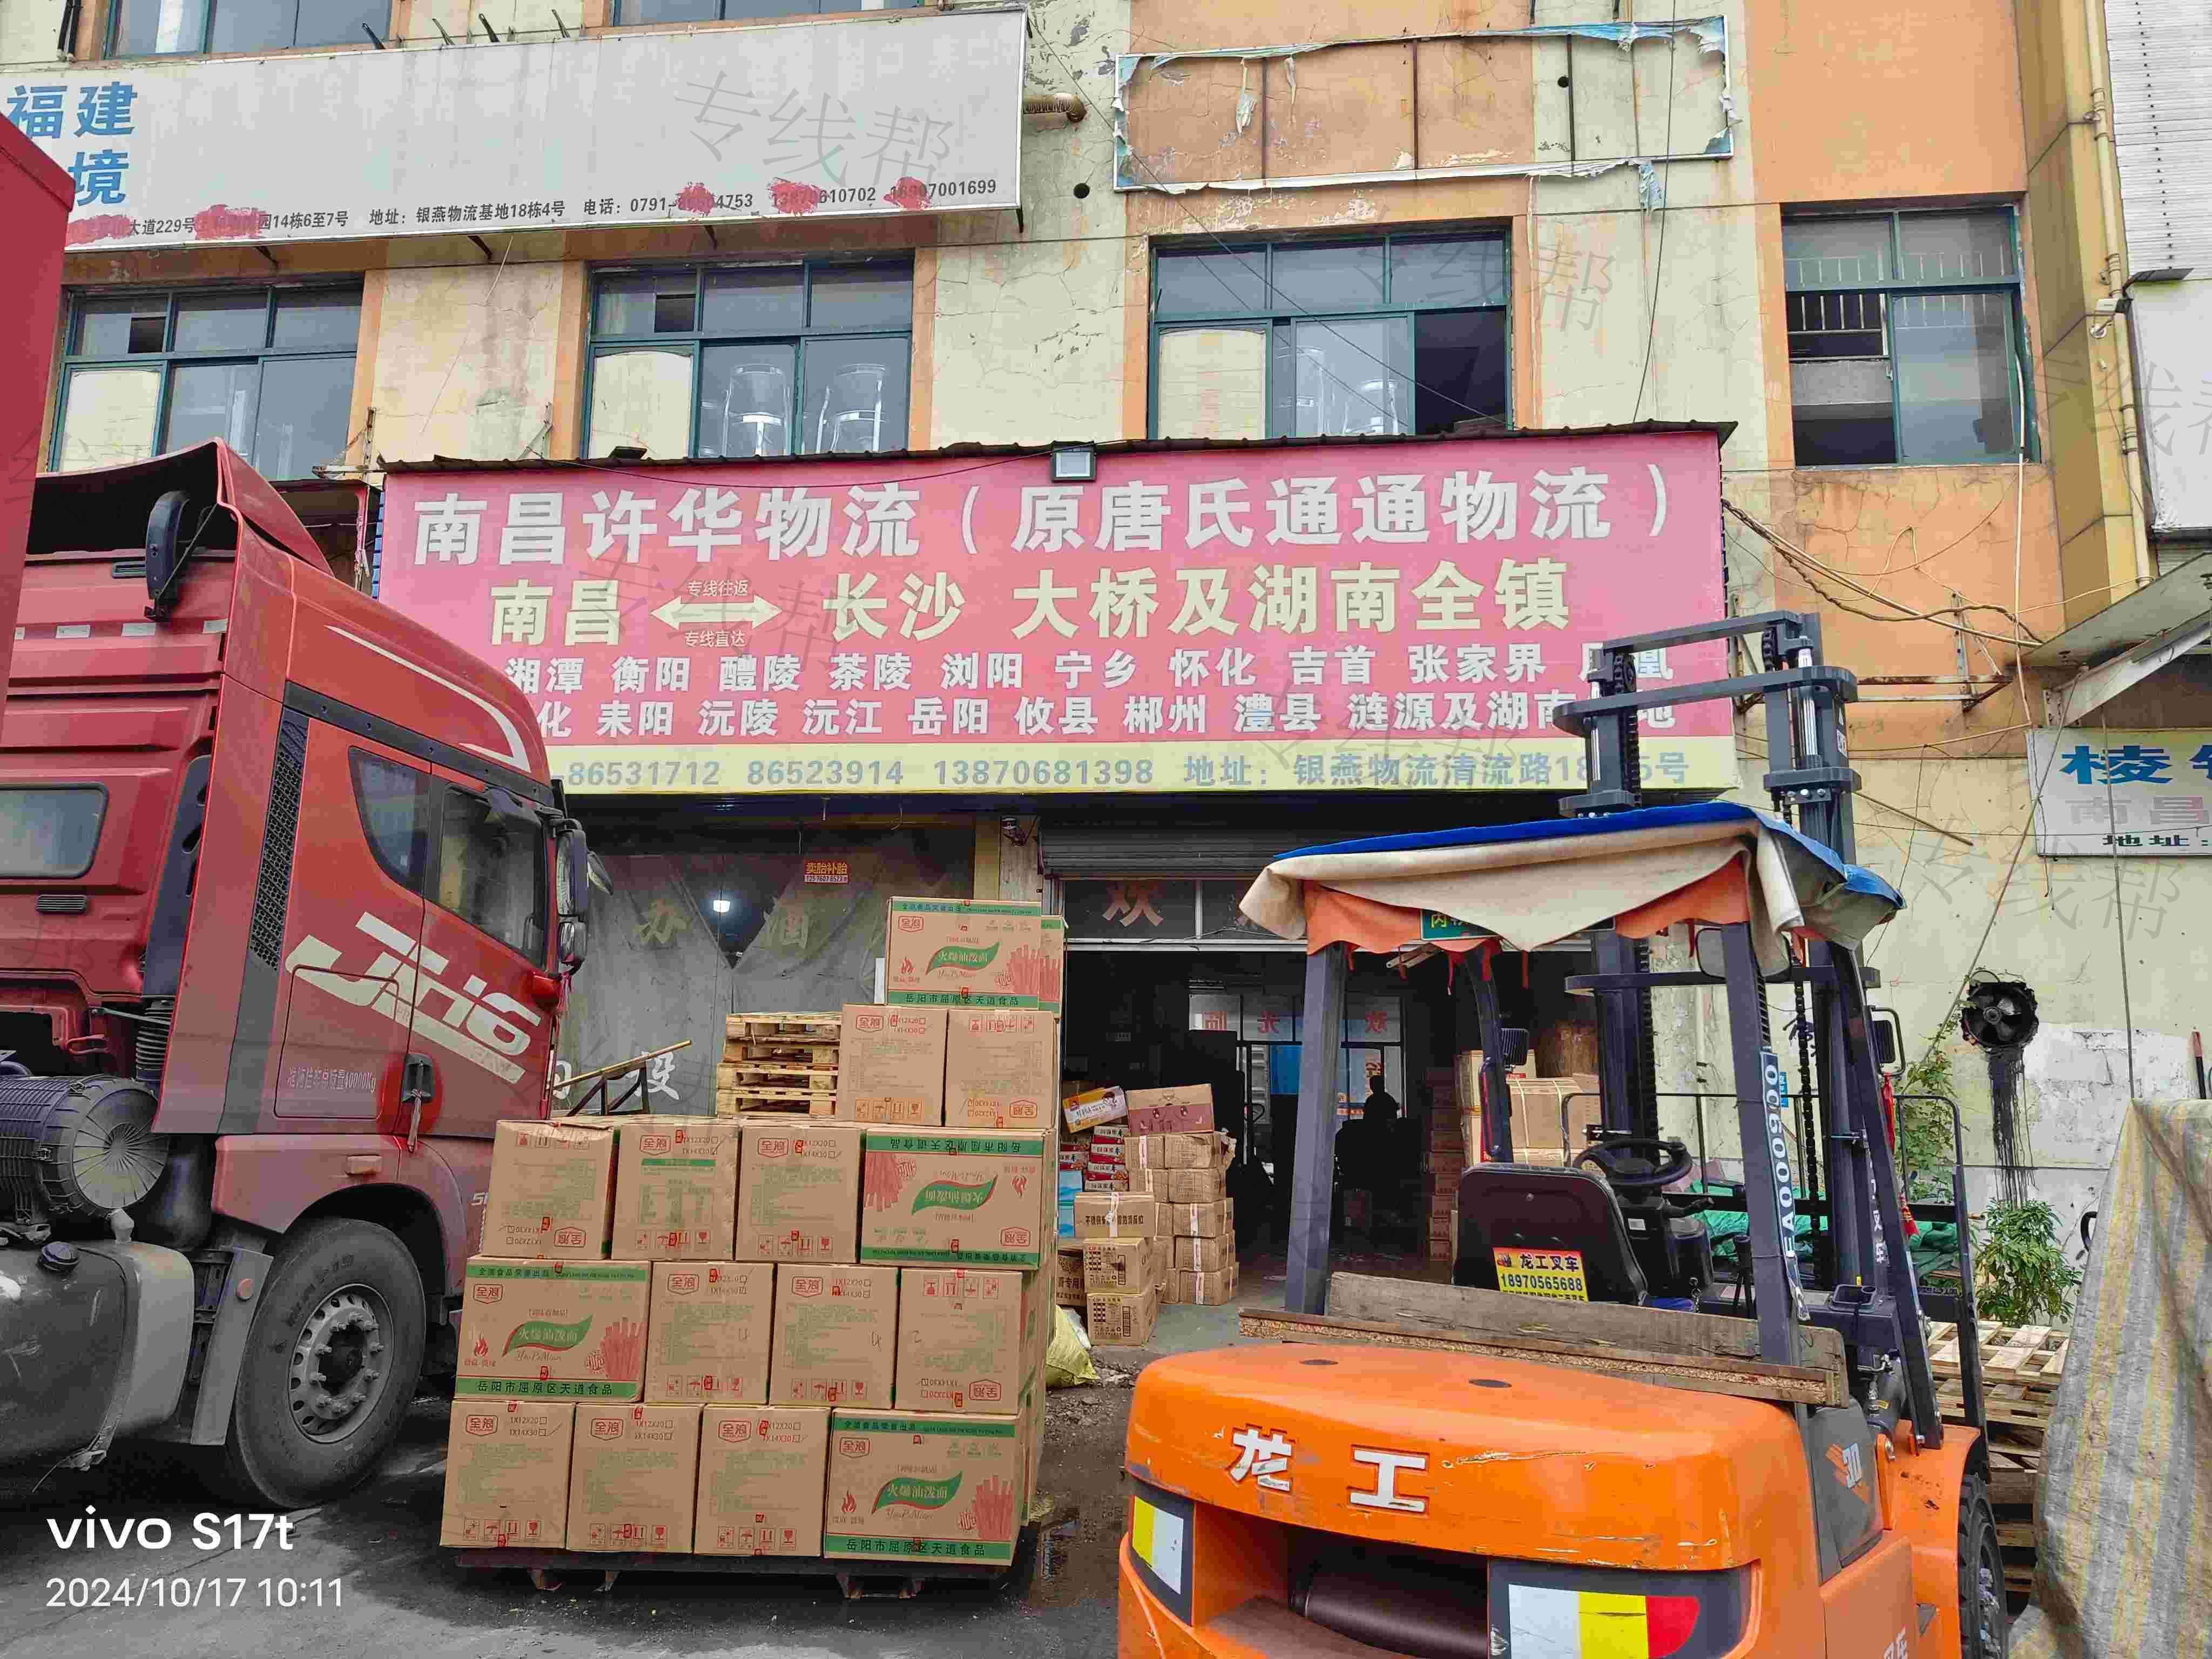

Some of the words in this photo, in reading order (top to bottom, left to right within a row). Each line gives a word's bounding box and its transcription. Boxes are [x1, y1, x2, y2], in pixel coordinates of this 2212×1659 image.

[6, 82, 138, 139] 福建
[69, 149, 129, 206] 境
[490, 579, 620, 646] 南昌
[822, 572, 967, 642] 长沙
[1011, 558, 1570, 639] 大桥及湖南全镇
[686, 579, 749, 598] 专线往返
[684, 630, 746, 648] 专线直达
[504, 657, 584, 695] 湘潭
[610, 656, 691, 693] 衡阳
[718, 655, 800, 693] 醴陵
[829, 652, 913, 692] 茶陵
[940, 652, 1023, 690] 浏阳
[1055, 649, 1137, 690] 宁乡
[1168, 647, 1258, 689] 怀化
[1289, 645, 1377, 686] 吉首
[1407, 643, 1547, 685] 张家界
[536, 700, 571, 739] 化
[595, 700, 675, 738] 耒阳
[698, 699, 779, 738] 沅陵
[802, 698, 882, 736] 沅江
[907, 697, 989, 735] 岳阳
[1014, 696, 1098, 734] 攸县
[1123, 694, 1207, 734] 郴州
[1233, 693, 1322, 733] 澧县
[1347, 688, 1675, 732] 涟源及湖南地
[569, 760, 720, 787] 86531712
[747, 760, 904, 786] 86523914
[934, 759, 1153, 785] 13870681398
[2059, 744, 2212, 785] 棱
[1501, 1273, 1583, 1292] 18970565688
[1519, 1253, 1580, 1272] 龙工叉车
[478, 1381, 612, 1395] 岳阳市屈原区天道食品
[1230, 1427, 1426, 1513] 龙工
